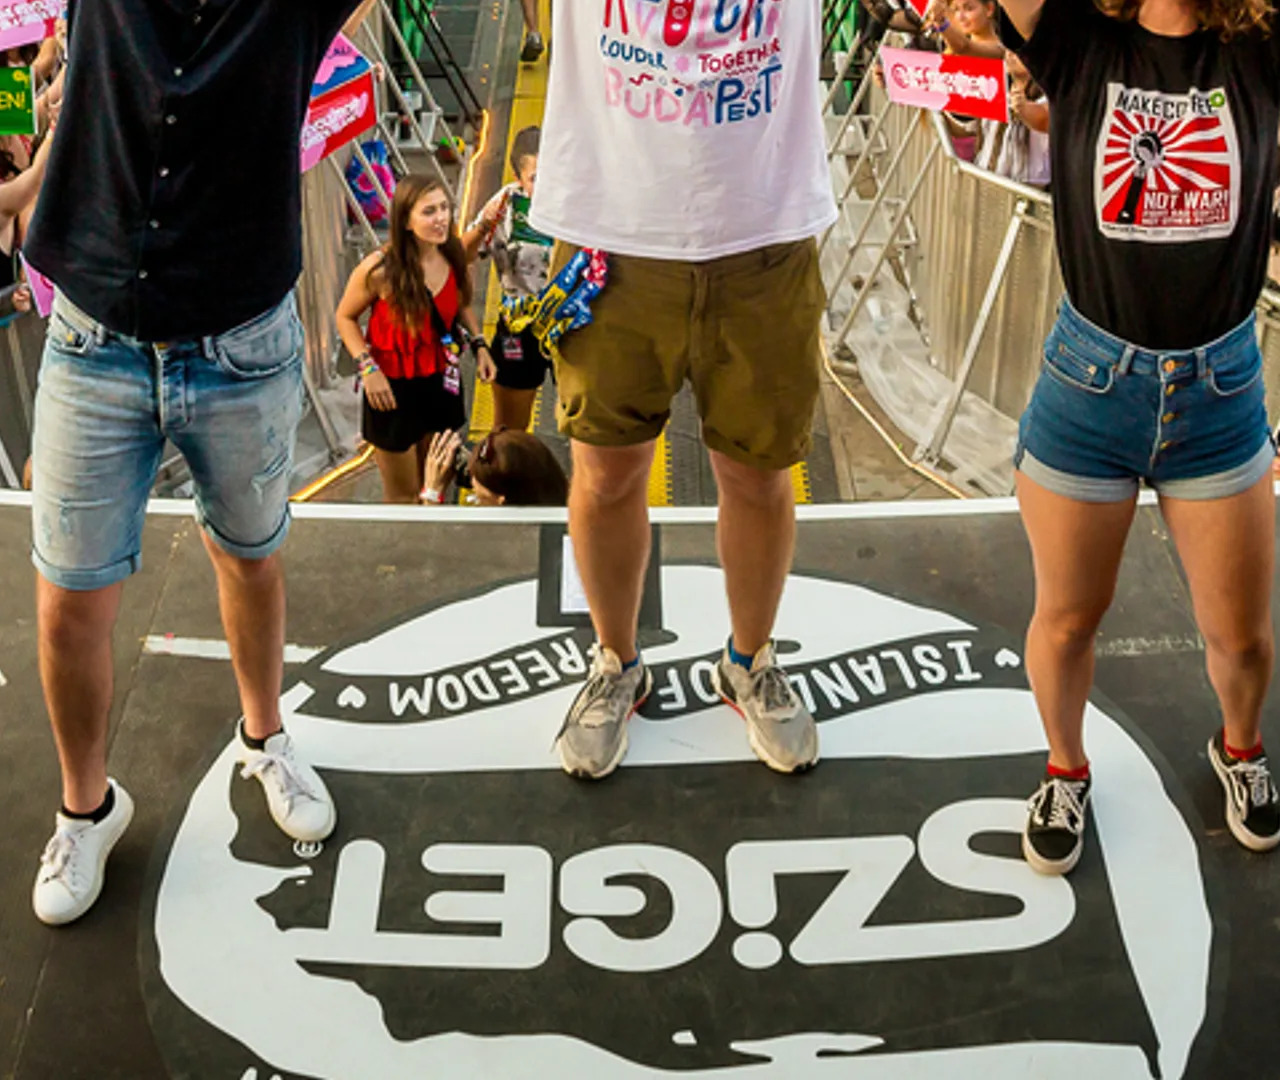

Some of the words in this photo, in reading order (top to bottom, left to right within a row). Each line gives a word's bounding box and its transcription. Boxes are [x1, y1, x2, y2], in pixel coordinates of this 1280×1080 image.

[1144, 191, 1181, 209] NOT
[1184, 191, 1228, 208] WAR!
[388, 635, 592, 717] REEDOM
